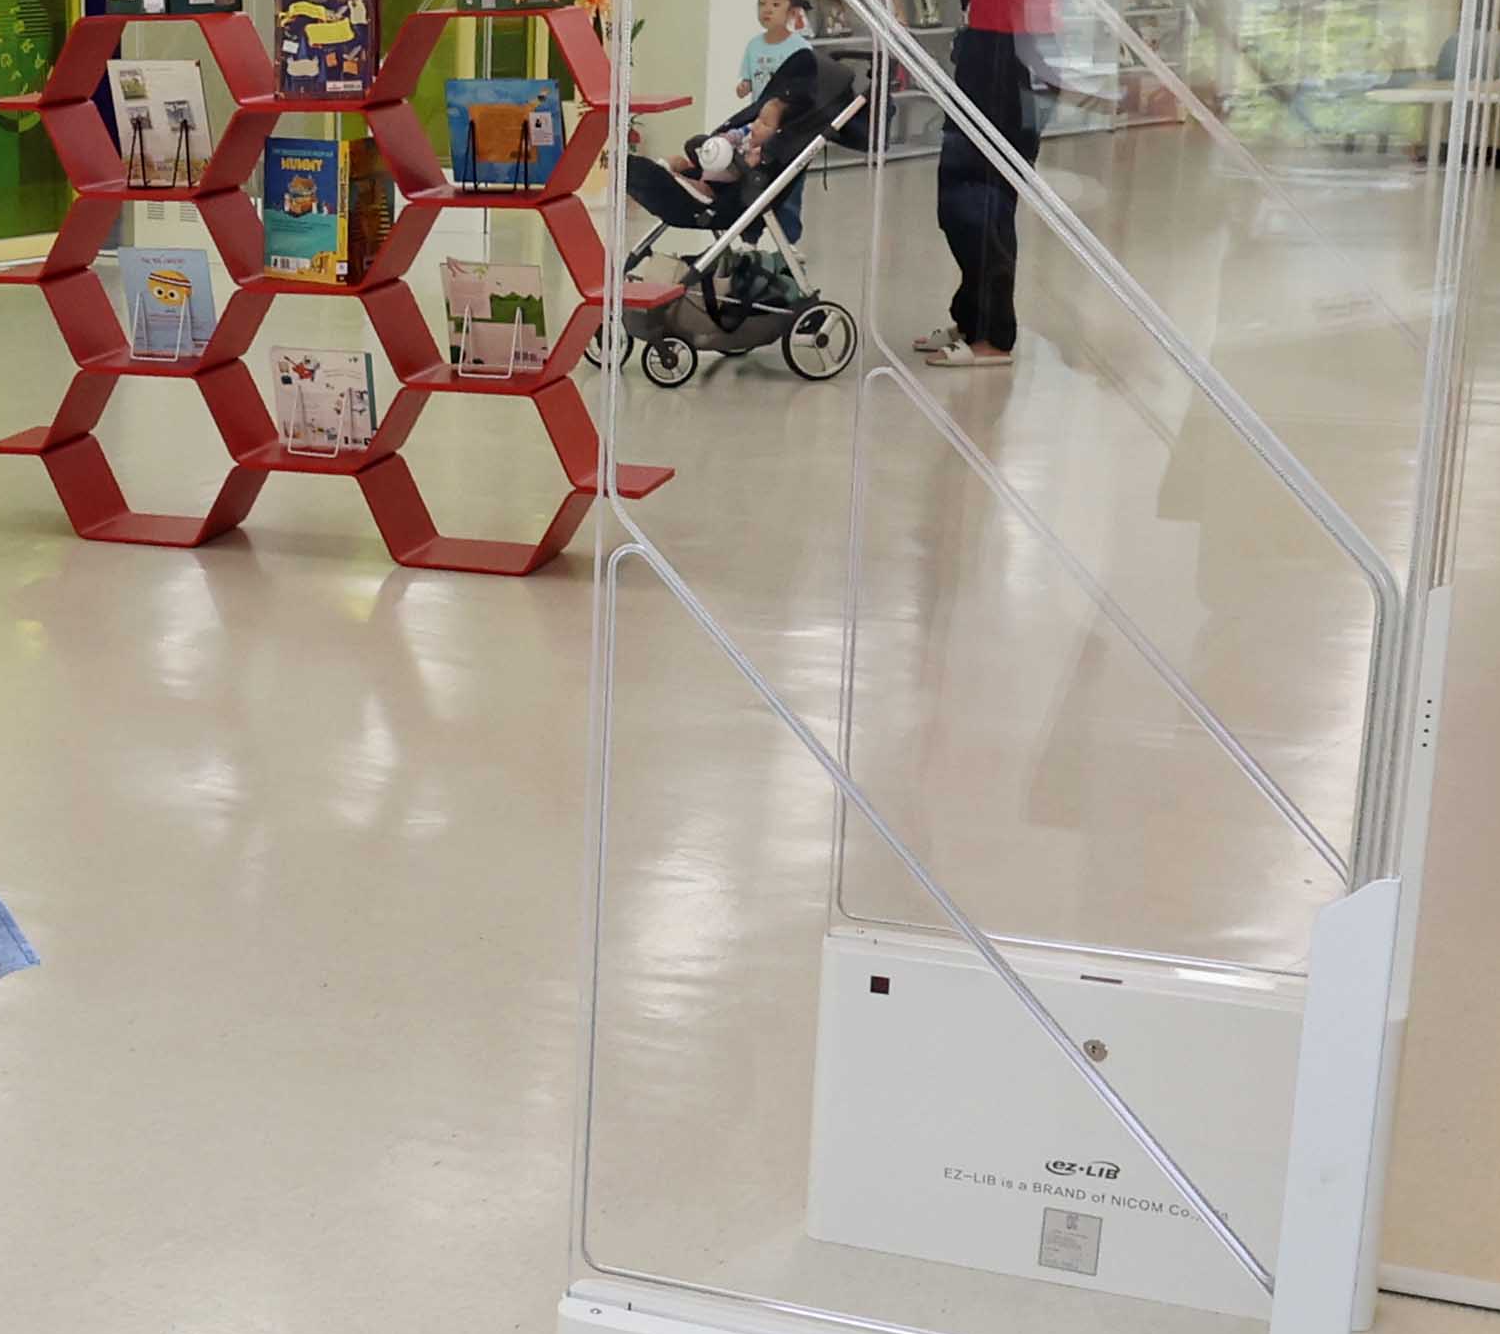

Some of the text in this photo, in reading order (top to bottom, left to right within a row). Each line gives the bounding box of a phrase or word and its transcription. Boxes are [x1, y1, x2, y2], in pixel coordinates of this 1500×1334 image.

[1001, 1179, 1013, 1189] is
[1017, 1181, 1028, 1191] a
[1032, 1182, 1087, 1201] BRAND
[1091, 1192, 1106, 1204] of
[1111, 1194, 1163, 1214] NICOM
